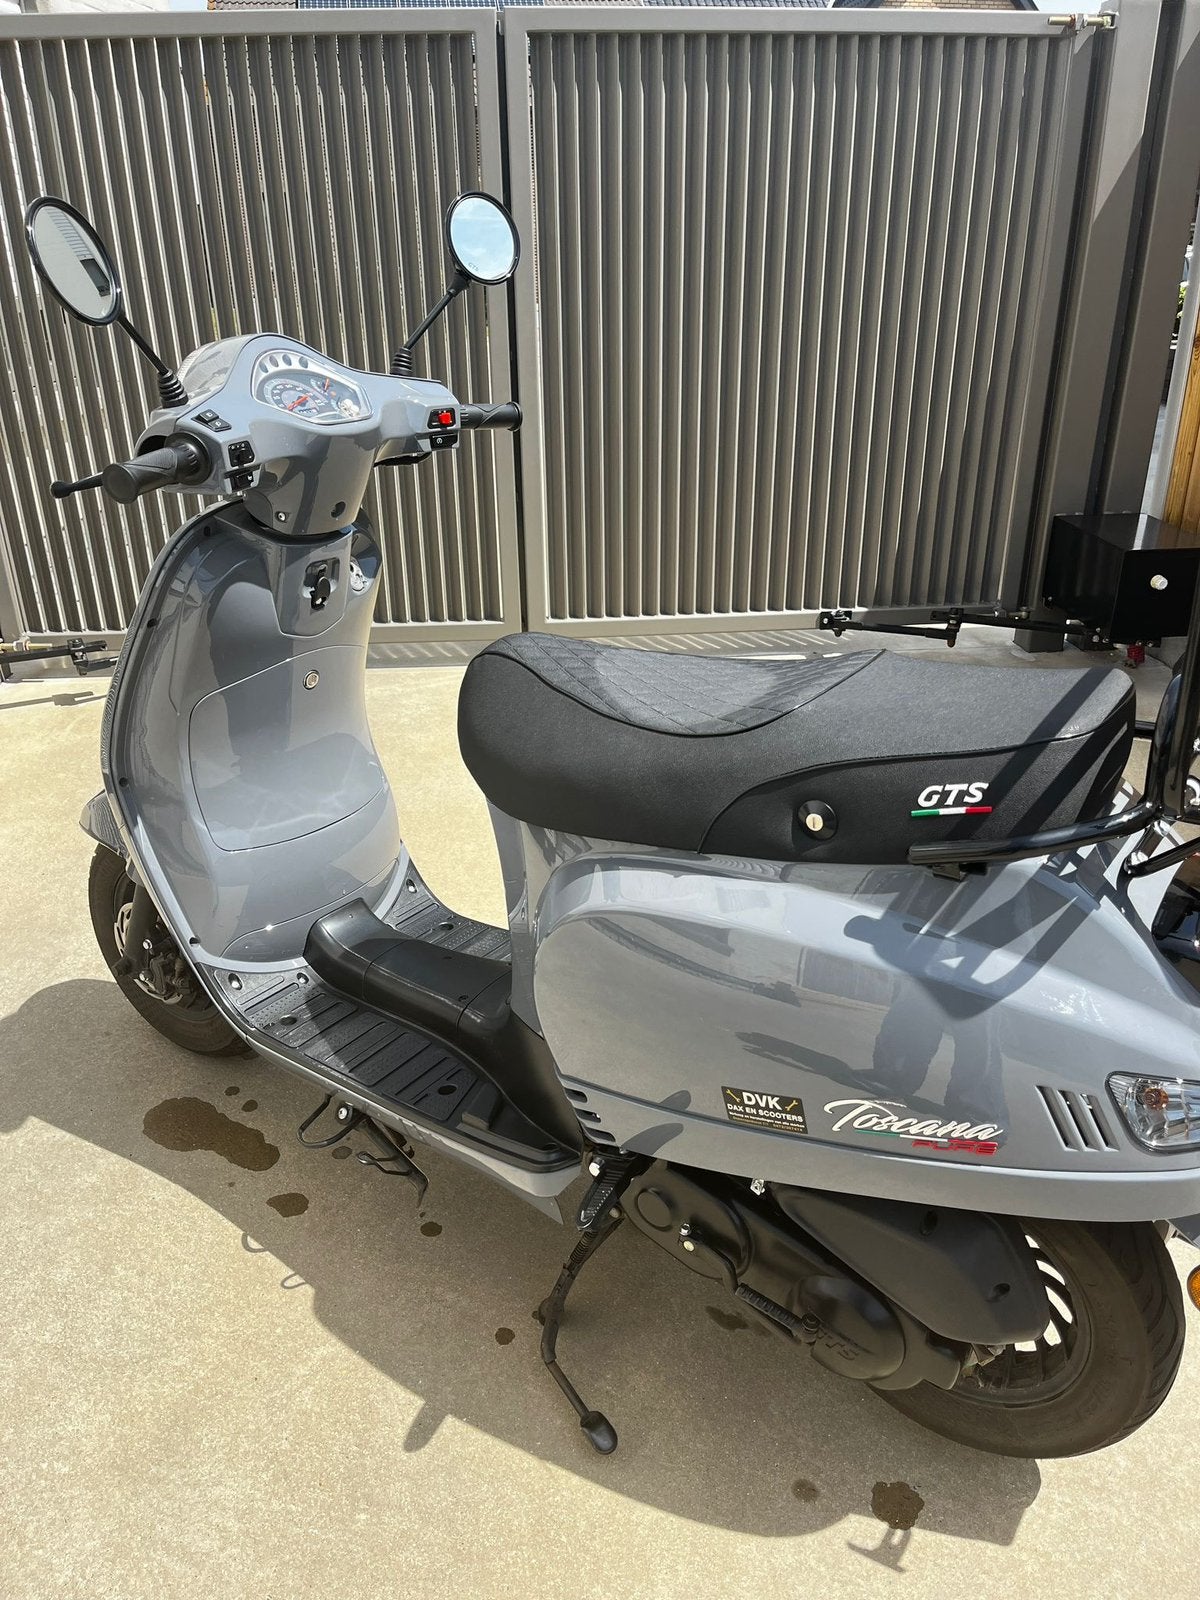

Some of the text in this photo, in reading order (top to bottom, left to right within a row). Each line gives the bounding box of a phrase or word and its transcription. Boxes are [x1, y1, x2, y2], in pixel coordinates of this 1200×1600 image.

[917, 782, 989, 808] GTS
[742, 1091, 782, 1110] DVK
[727, 1103, 804, 1122] DAX EN SCOOTERS
[823, 1099, 1003, 1140] Toscana
[912, 1138, 999, 1156] PURE
